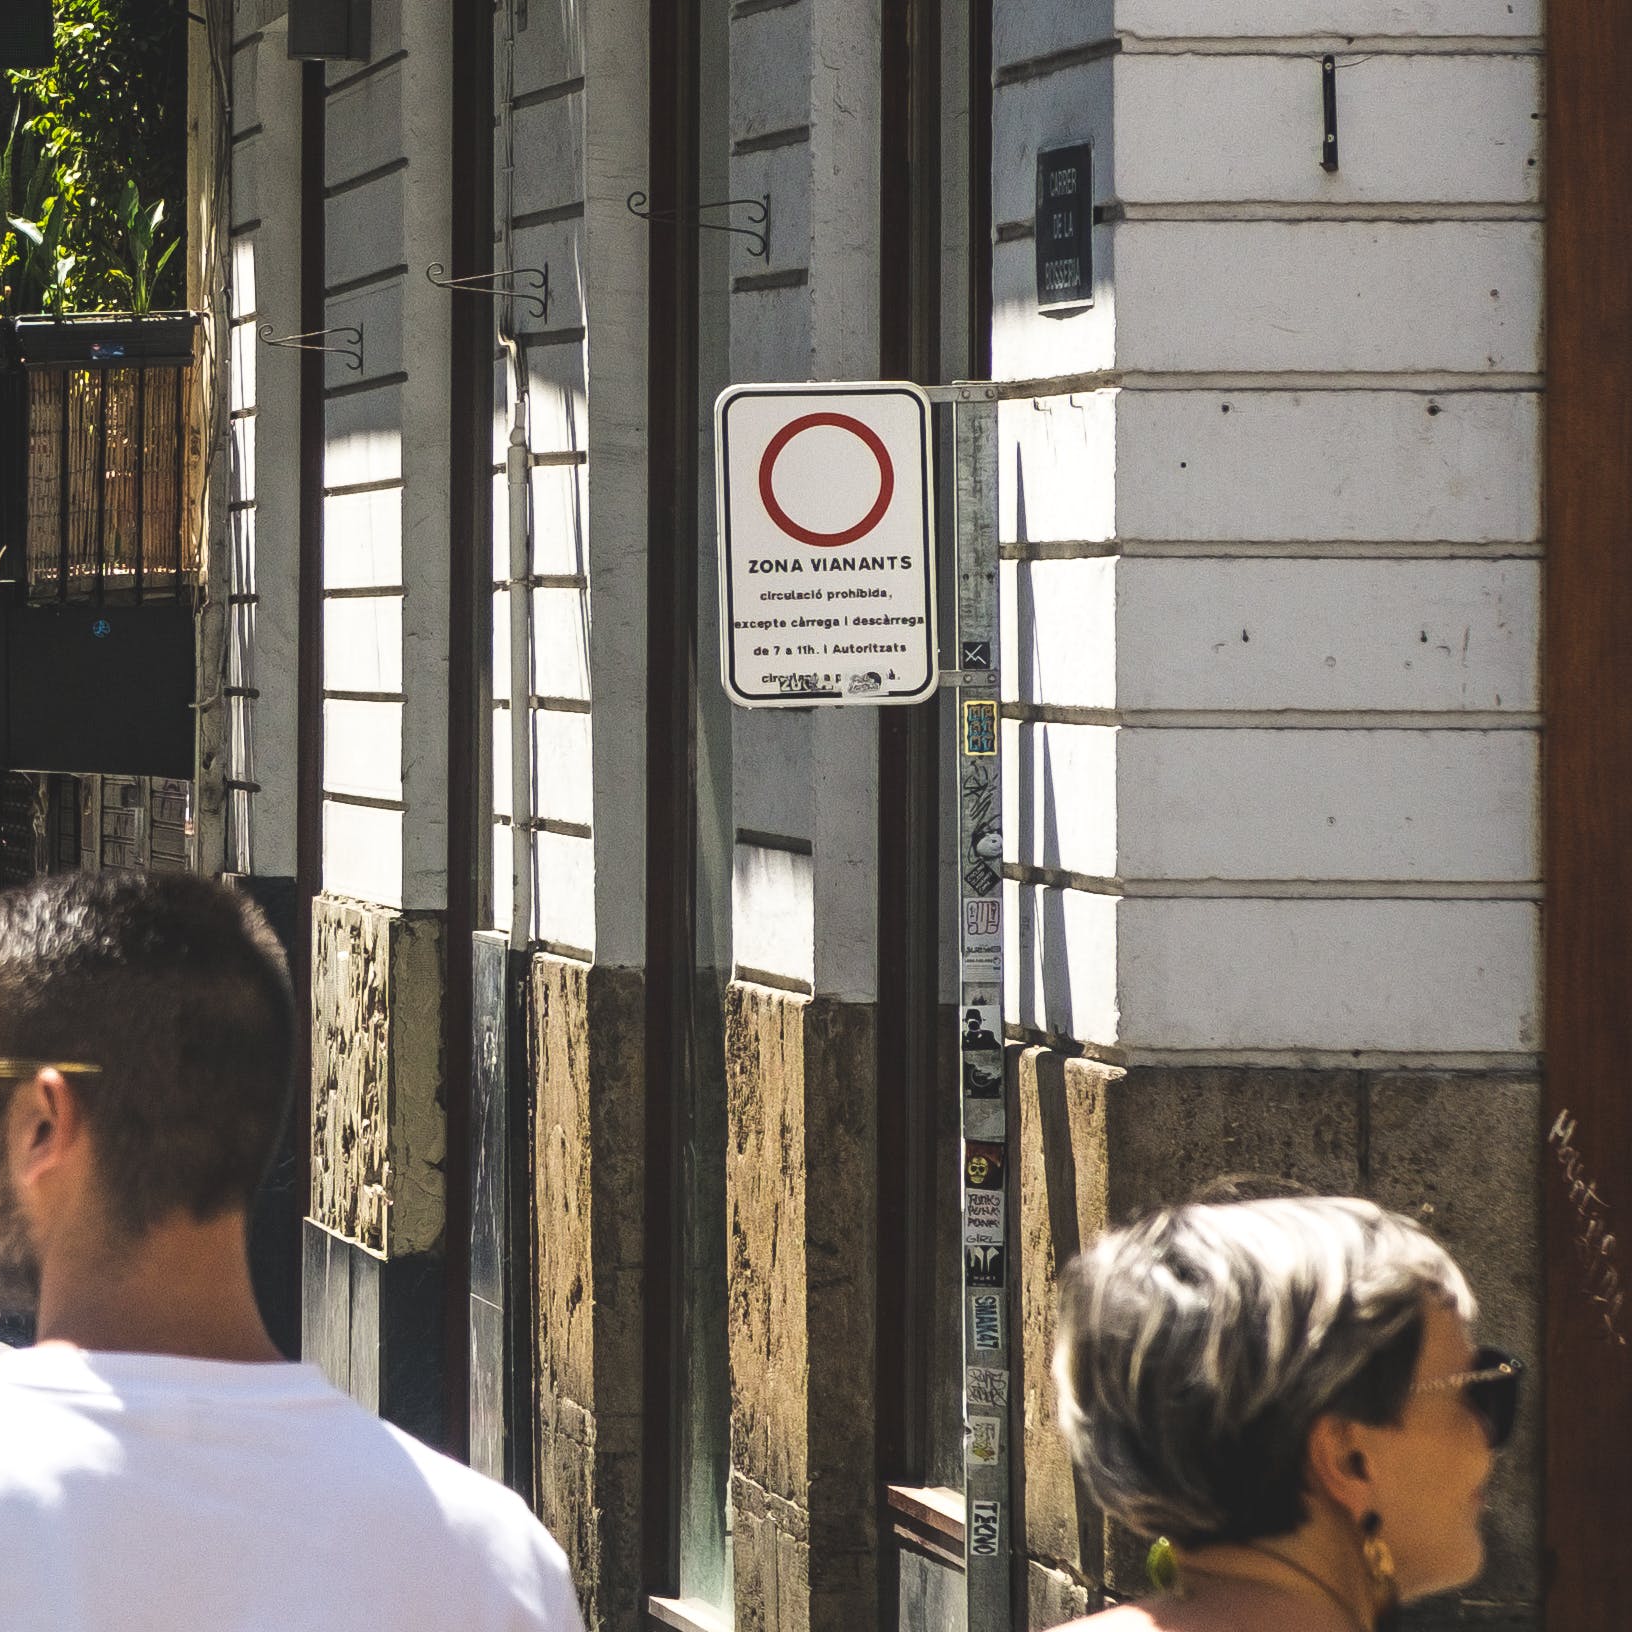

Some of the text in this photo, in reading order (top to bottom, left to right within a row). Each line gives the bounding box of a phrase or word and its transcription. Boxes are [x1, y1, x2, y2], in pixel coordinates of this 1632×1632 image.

[1049, 167, 1078, 198] CARRER
[1053, 211, 1073, 239] DE LA
[748, 555, 913, 574] ZONA VIANANTS
[760, 587, 893, 602] circulació prohibida,
[734, 618, 787, 630] excepte
[791, 616, 840, 629] càrrega
[852, 613, 925, 627] descàrrega
[753, 646, 769, 656] de
[774, 646, 781, 656] 7
[786, 648, 793, 656] a
[832, 643, 907, 655] Autoritzats
[823, 674, 831, 682] a
[966, 1234, 1002, 1244] GIRL
